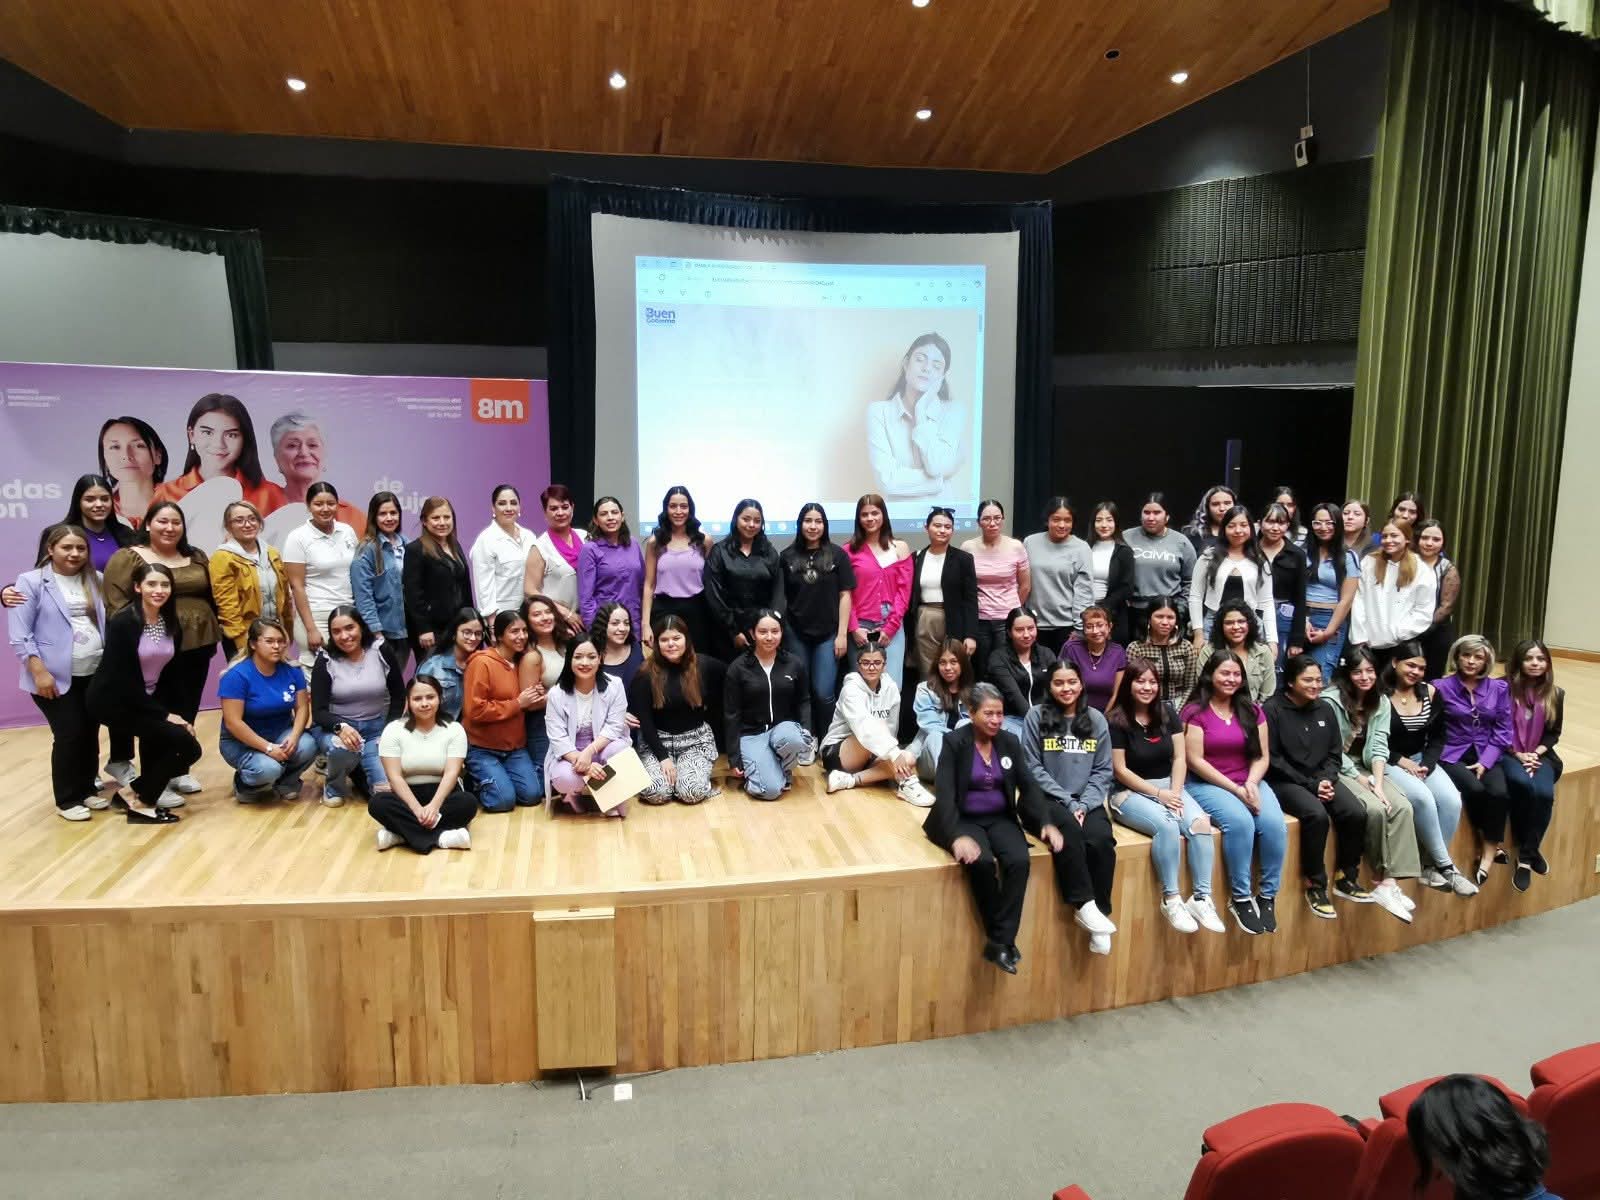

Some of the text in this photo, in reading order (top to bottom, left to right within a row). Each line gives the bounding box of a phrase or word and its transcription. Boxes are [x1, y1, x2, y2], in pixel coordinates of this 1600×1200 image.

[646, 308, 676, 319] Buen
[478, 399, 524, 419] 8m
[0, 479, 62, 499] das
[374, 476, 403, 494] de
[1133, 547, 1176, 563] Calvin
[1043, 737, 1098, 753] HERITAGE
